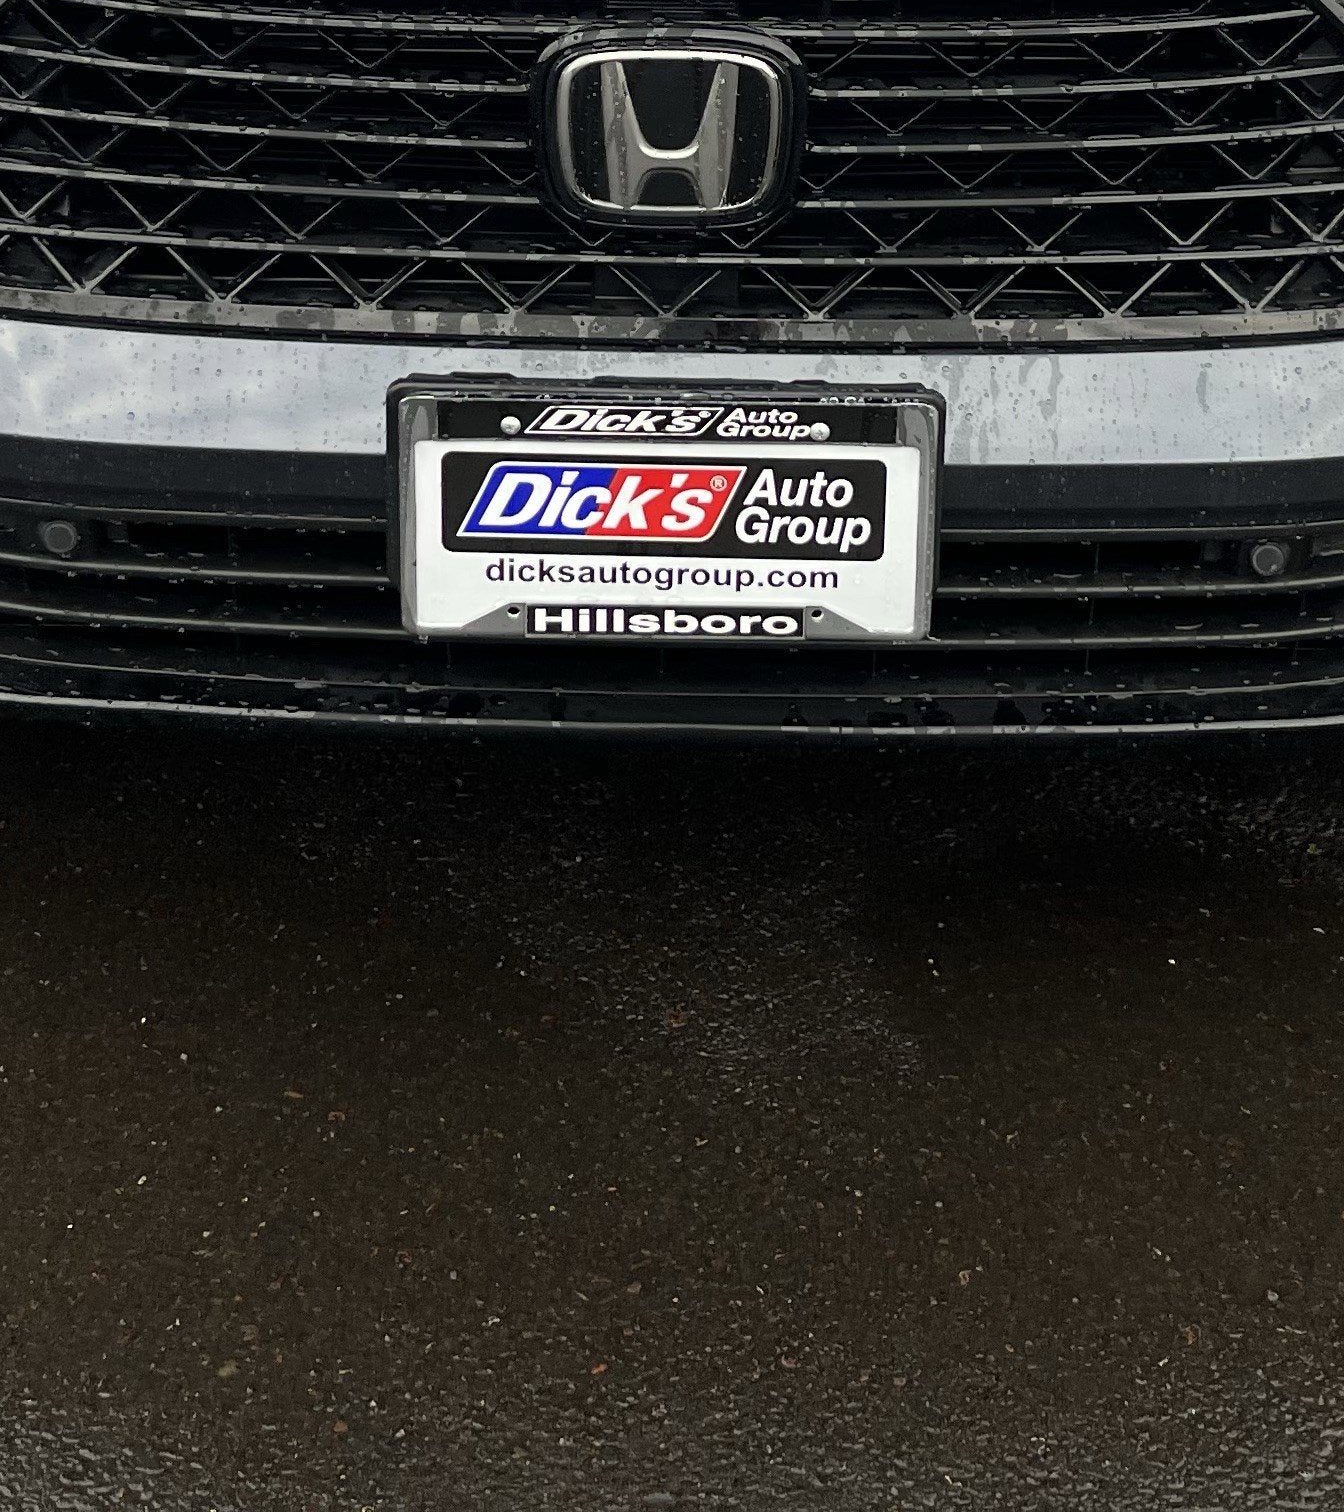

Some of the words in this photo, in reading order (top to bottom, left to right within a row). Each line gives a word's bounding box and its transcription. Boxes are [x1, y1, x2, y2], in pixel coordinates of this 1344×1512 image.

[717, 421, 811, 440] Group
[723, 408, 798, 424] Auto
[744, 469, 854, 508] Auto
[735, 507, 871, 553] Group
[486, 558, 839, 592] dicksautogroup.com
[533, 607, 798, 635] Hillsboro
